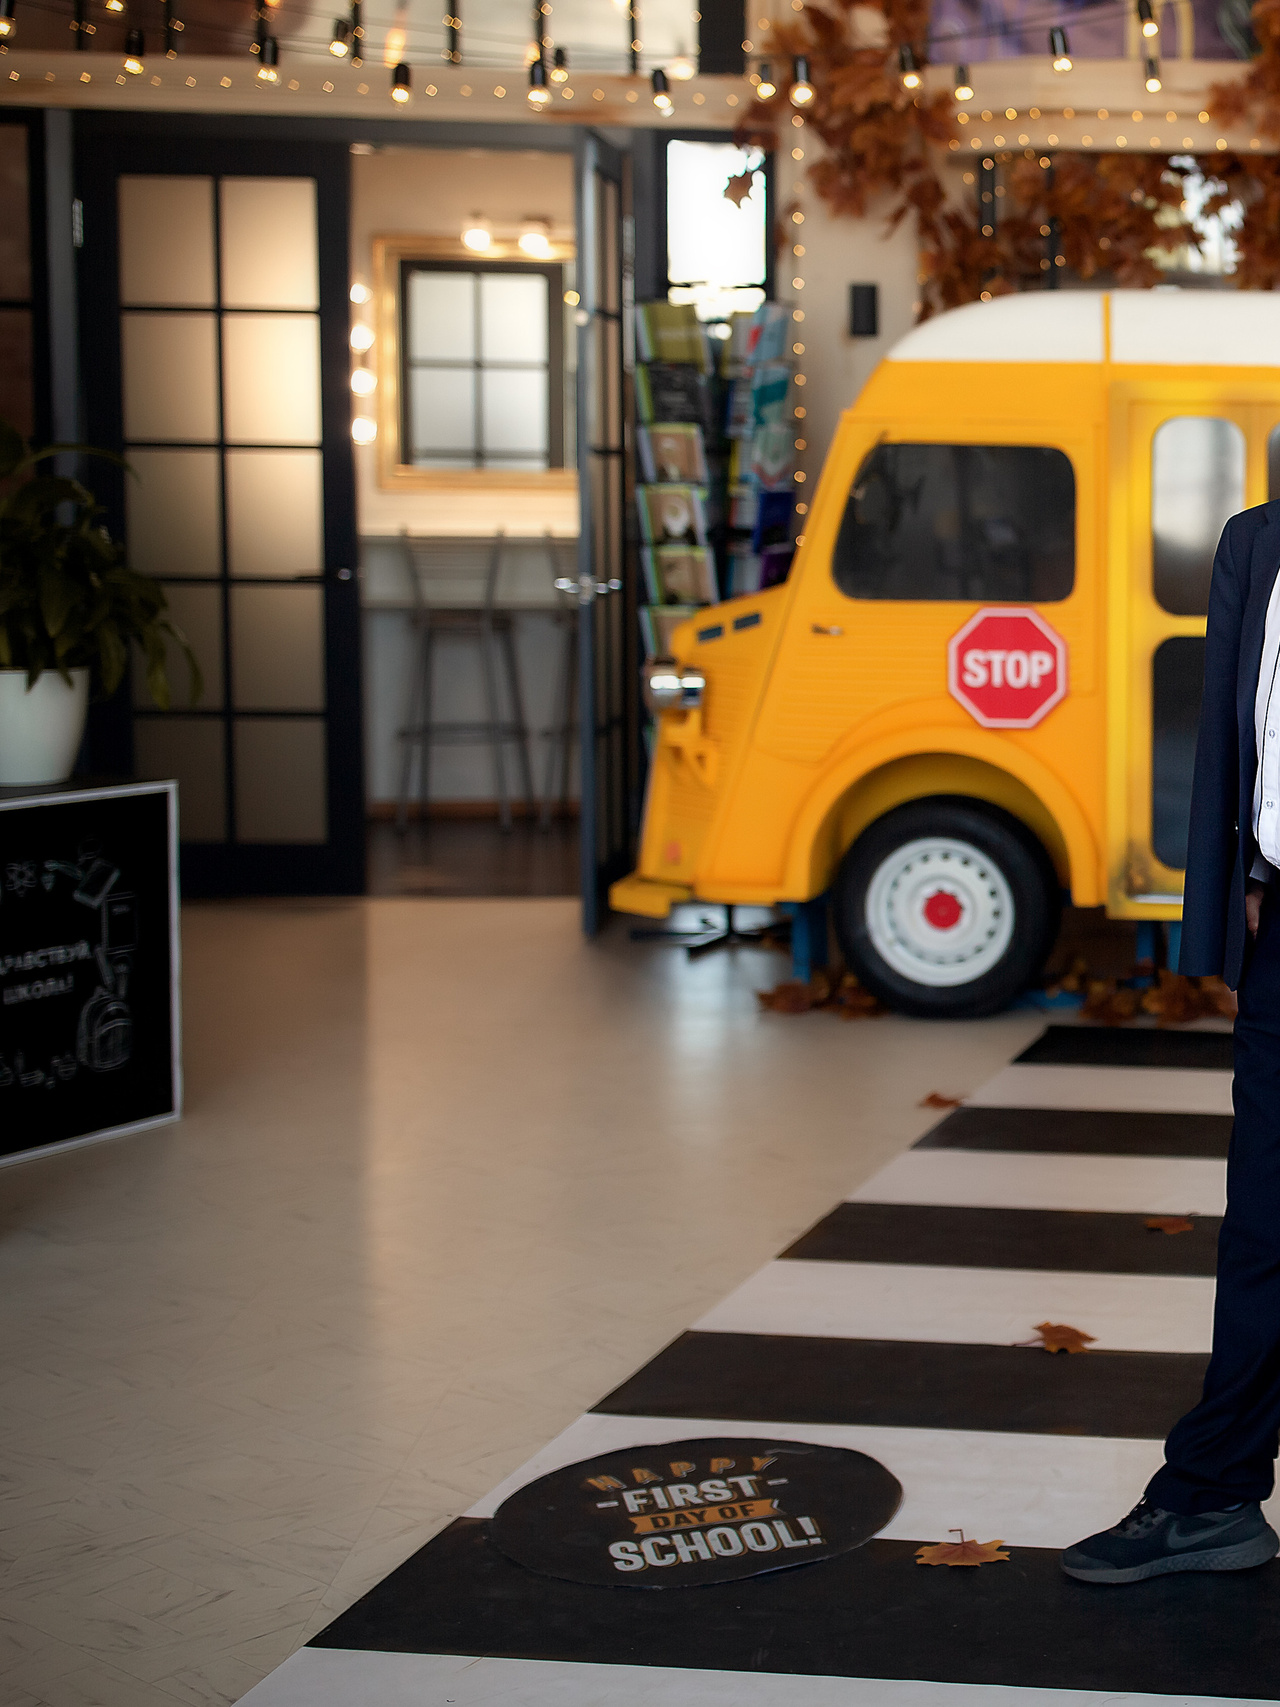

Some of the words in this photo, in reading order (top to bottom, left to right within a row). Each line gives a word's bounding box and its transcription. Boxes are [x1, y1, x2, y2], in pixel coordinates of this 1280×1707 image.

[962, 648, 1054, 690] STOP
[586, 1456, 778, 1491] HAPPY
[650, 1510, 707, 1529] DAY
[719, 1504, 756, 1519] OF
[608, 1516, 827, 1573] SCHOOL!
